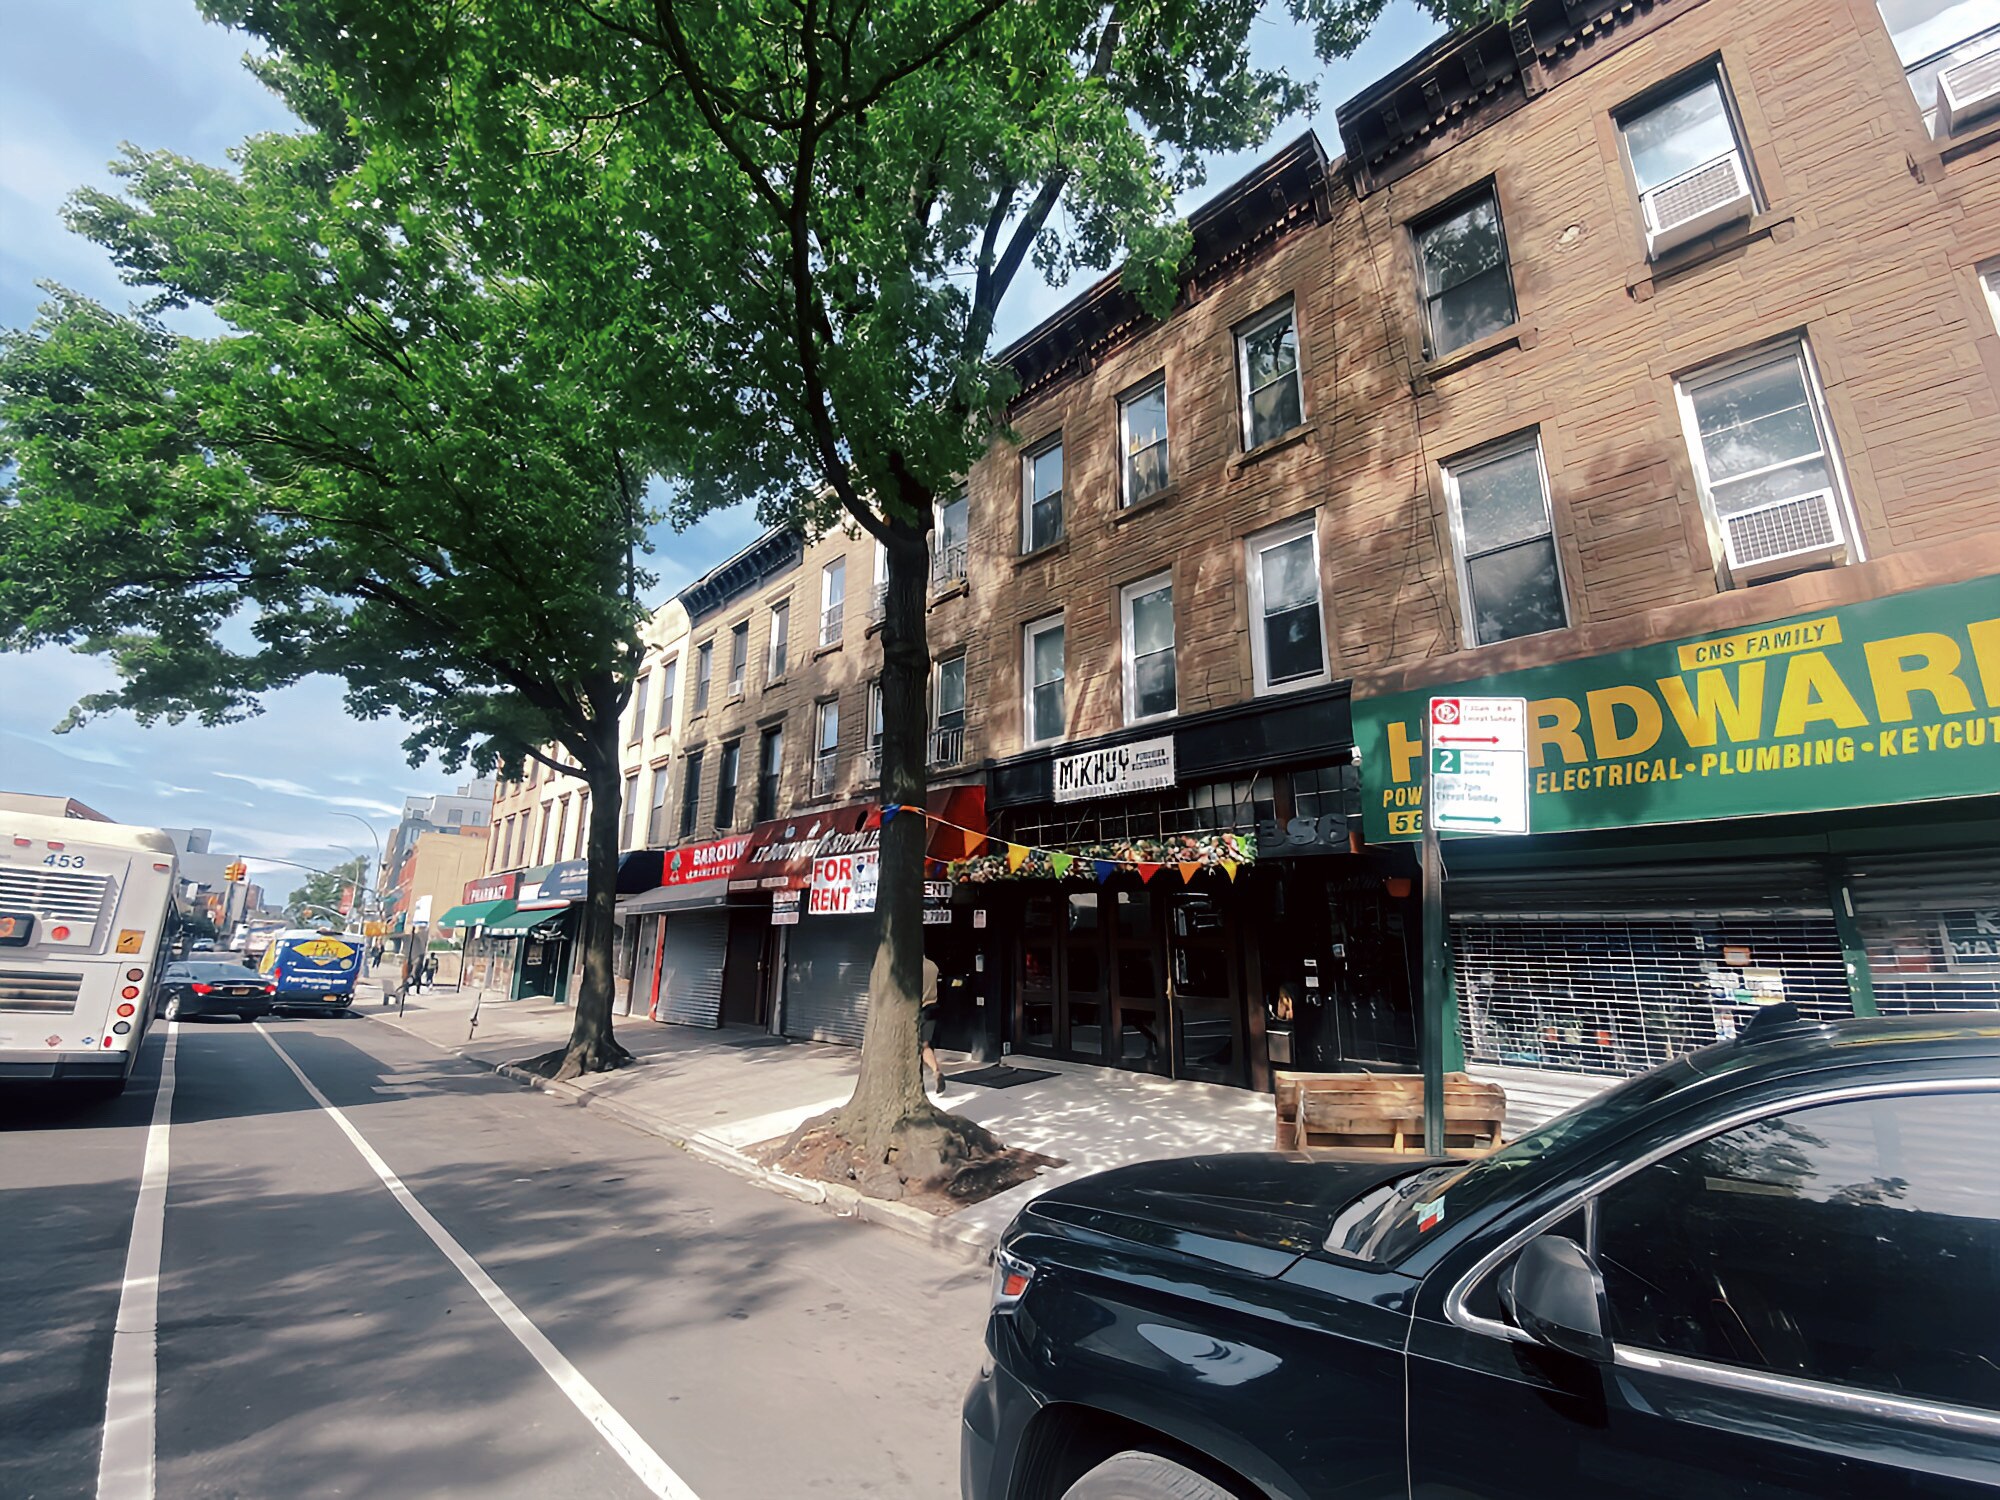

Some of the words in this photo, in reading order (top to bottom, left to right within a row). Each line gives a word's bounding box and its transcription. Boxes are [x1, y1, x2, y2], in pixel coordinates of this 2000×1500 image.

[1695, 641, 1735, 664] CNS
[1746, 623, 1826, 656] FAMILY
[1387, 617, 2000, 784] HRDWAR
[1059, 747, 1130, 791] MIKHUY
[1383, 785, 1423, 809] POW
[1536, 755, 1684, 795] ELECTRICAL
[1701, 735, 1855, 778] PLUMBING
[1439, 750, 1454, 772] 2
[1395, 813, 1423, 832] 58
[43, 853, 85, 869] 453
[813, 857, 852, 882] FOR
[810, 886, 851, 913] RENT
[923, 882, 951, 897] ENT
